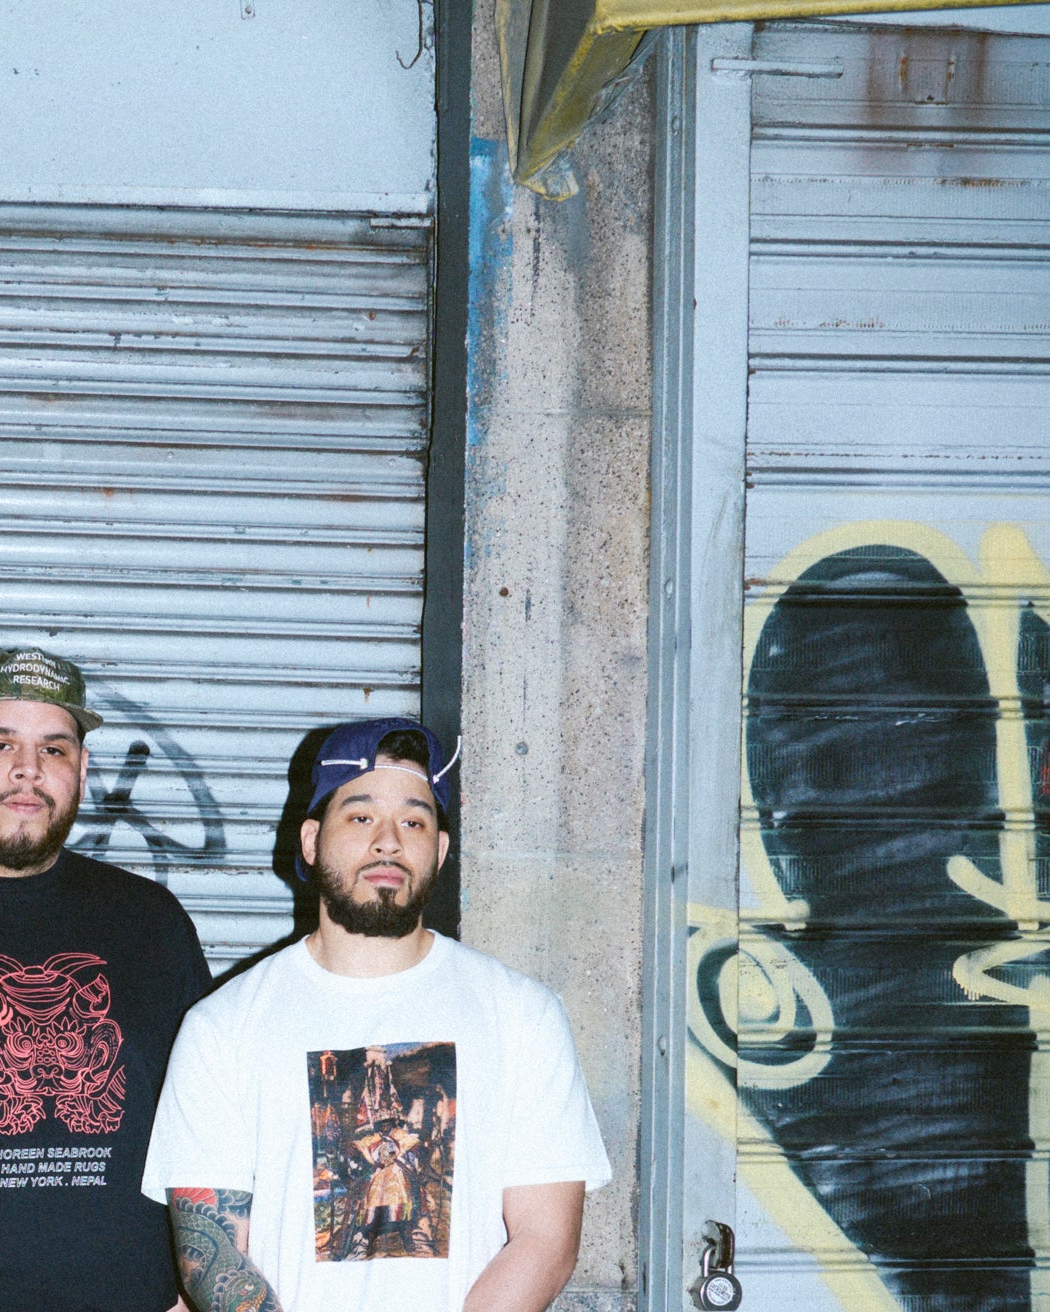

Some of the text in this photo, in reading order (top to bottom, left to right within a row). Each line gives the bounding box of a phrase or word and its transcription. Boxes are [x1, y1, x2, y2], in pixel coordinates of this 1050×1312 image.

[12, 675, 60, 692] RESEARCH
[46, 1146, 113, 1159] SEABROOK
[0, 1161, 107, 1175] HAND MADE RUGS
[30, 1176, 64, 1188] YORK
[71, 1175, 108, 1186] NEPAL
